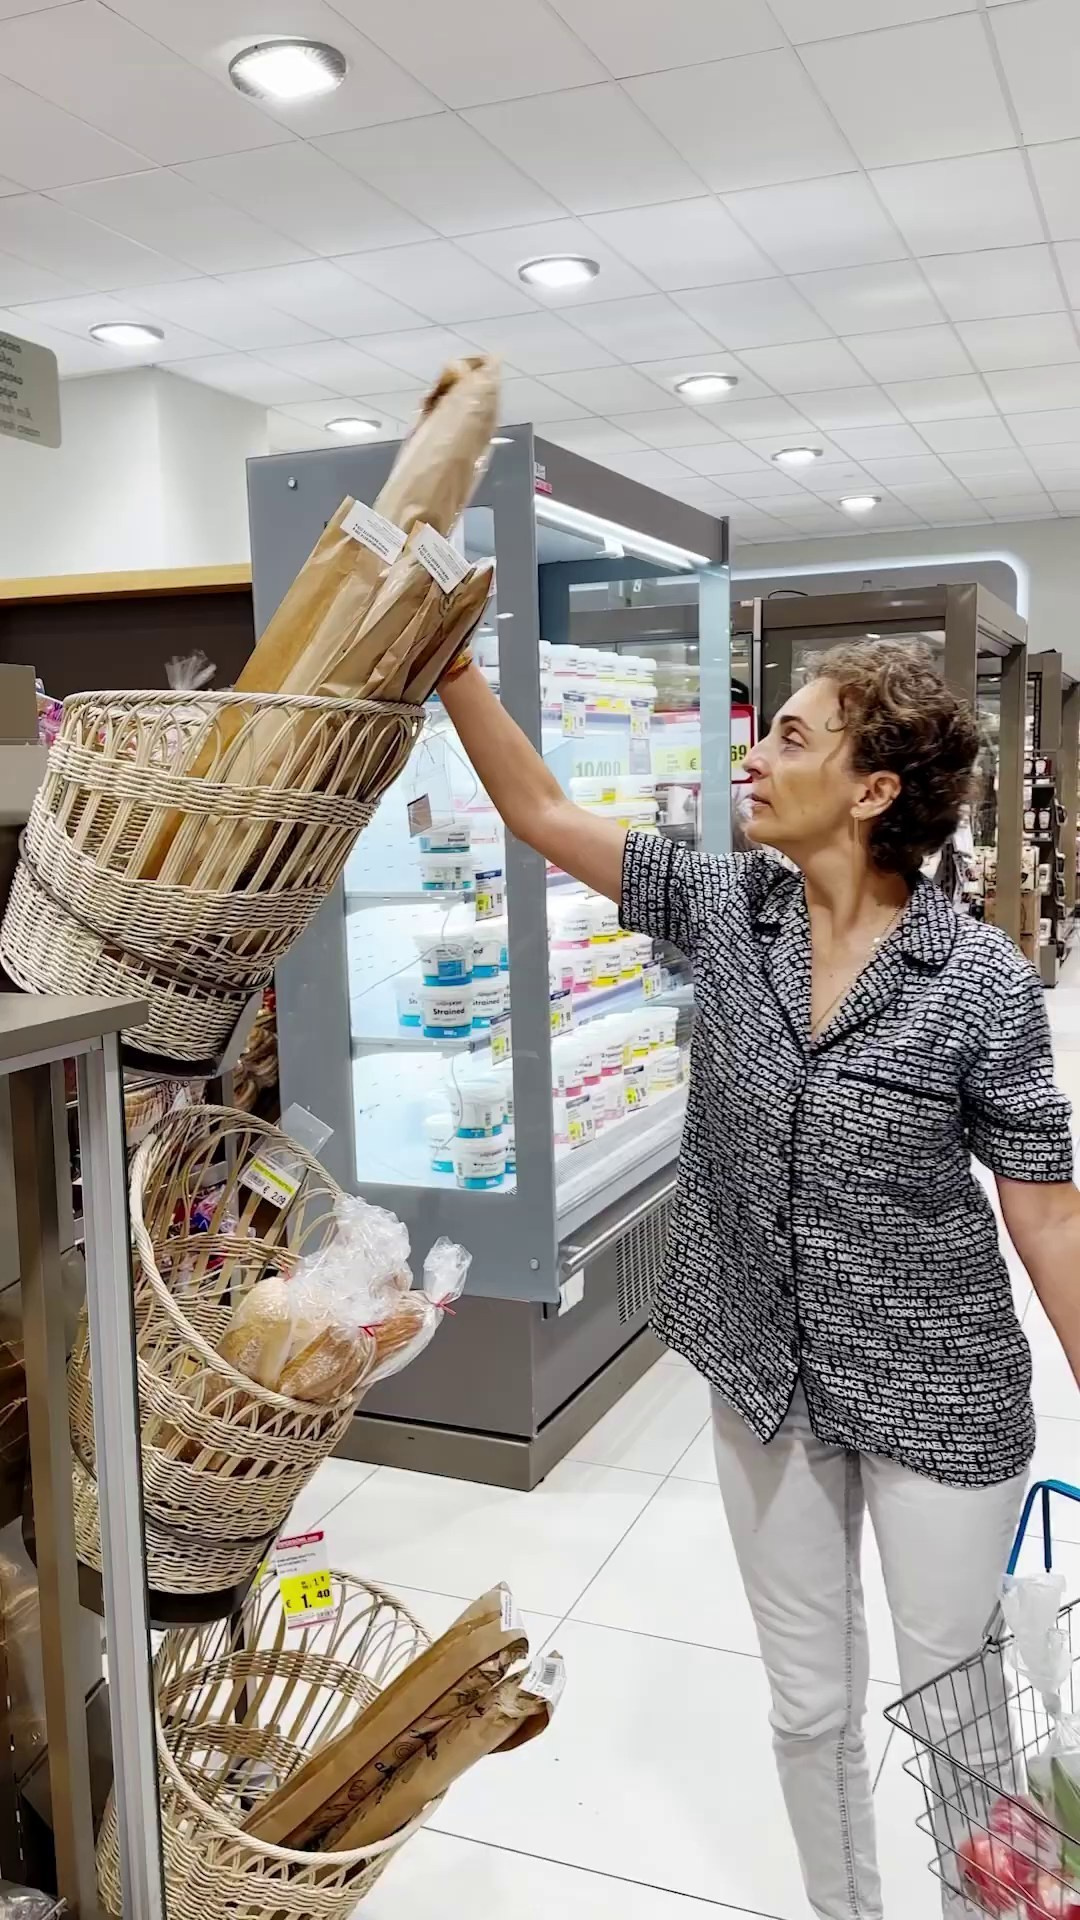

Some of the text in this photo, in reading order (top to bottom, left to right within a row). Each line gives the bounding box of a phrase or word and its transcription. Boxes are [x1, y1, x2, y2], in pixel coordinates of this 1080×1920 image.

[623, 851, 632, 890] MICHAEL
[659, 855, 668, 877] KORS
[631, 861, 640, 885] LOVE
[639, 876, 649, 902] KORS
[648, 870, 657, 900] PEACE
[630, 894, 639, 923] PEACE
[433, 1007, 465, 1015] Strained
[1001, 1093, 1029, 1105] LOVE
[1014, 1131, 1048, 1140] PEACE
[1024, 1142, 1052, 1152] KORS
[994, 1149, 1060, 1161] KORS LOVE
[1001, 1159, 1049, 1172] MICHAEL
[1003, 1170, 1069, 1181] KORS LOVE
[271, 1191, 287, 1206] 2.09
[851, 1284, 881, 1296] KORS
[891, 1287, 918, 1297] LOVE
[884, 1297, 928, 1307] MICHAEL
[887, 1308, 917, 1318] KORS
[925, 1309, 949, 1317] LOVE
[921, 1318, 962, 1328] MICHAEL
[852, 1338, 887, 1348] PEACE
[864, 1350, 893, 1360] KORS
[888, 1361, 924, 1371] PEACE
[846, 1370, 961, 1393] KORS LOVE PEACE
[900, 1372, 967, 1383] KORS LOVE
[830, 1376, 865, 1389] PEACE
[878, 1387, 925, 1402] MICHAEL
[936, 1395, 966, 1404] KORS
[825, 1385, 995, 1414] MICHAEL KORS LOVE PEACE
[867, 1404, 902, 1416] PEACE
[861, 1411, 908, 1427] MICHAEL
[919, 1421, 948, 1431] KORS
[904, 1427, 939, 1440] PEACE
[899, 1438, 943, 1450] MICHAEL
[956, 1444, 985, 1452] KORS
[903, 1449, 976, 1462] LOVE PEACE
